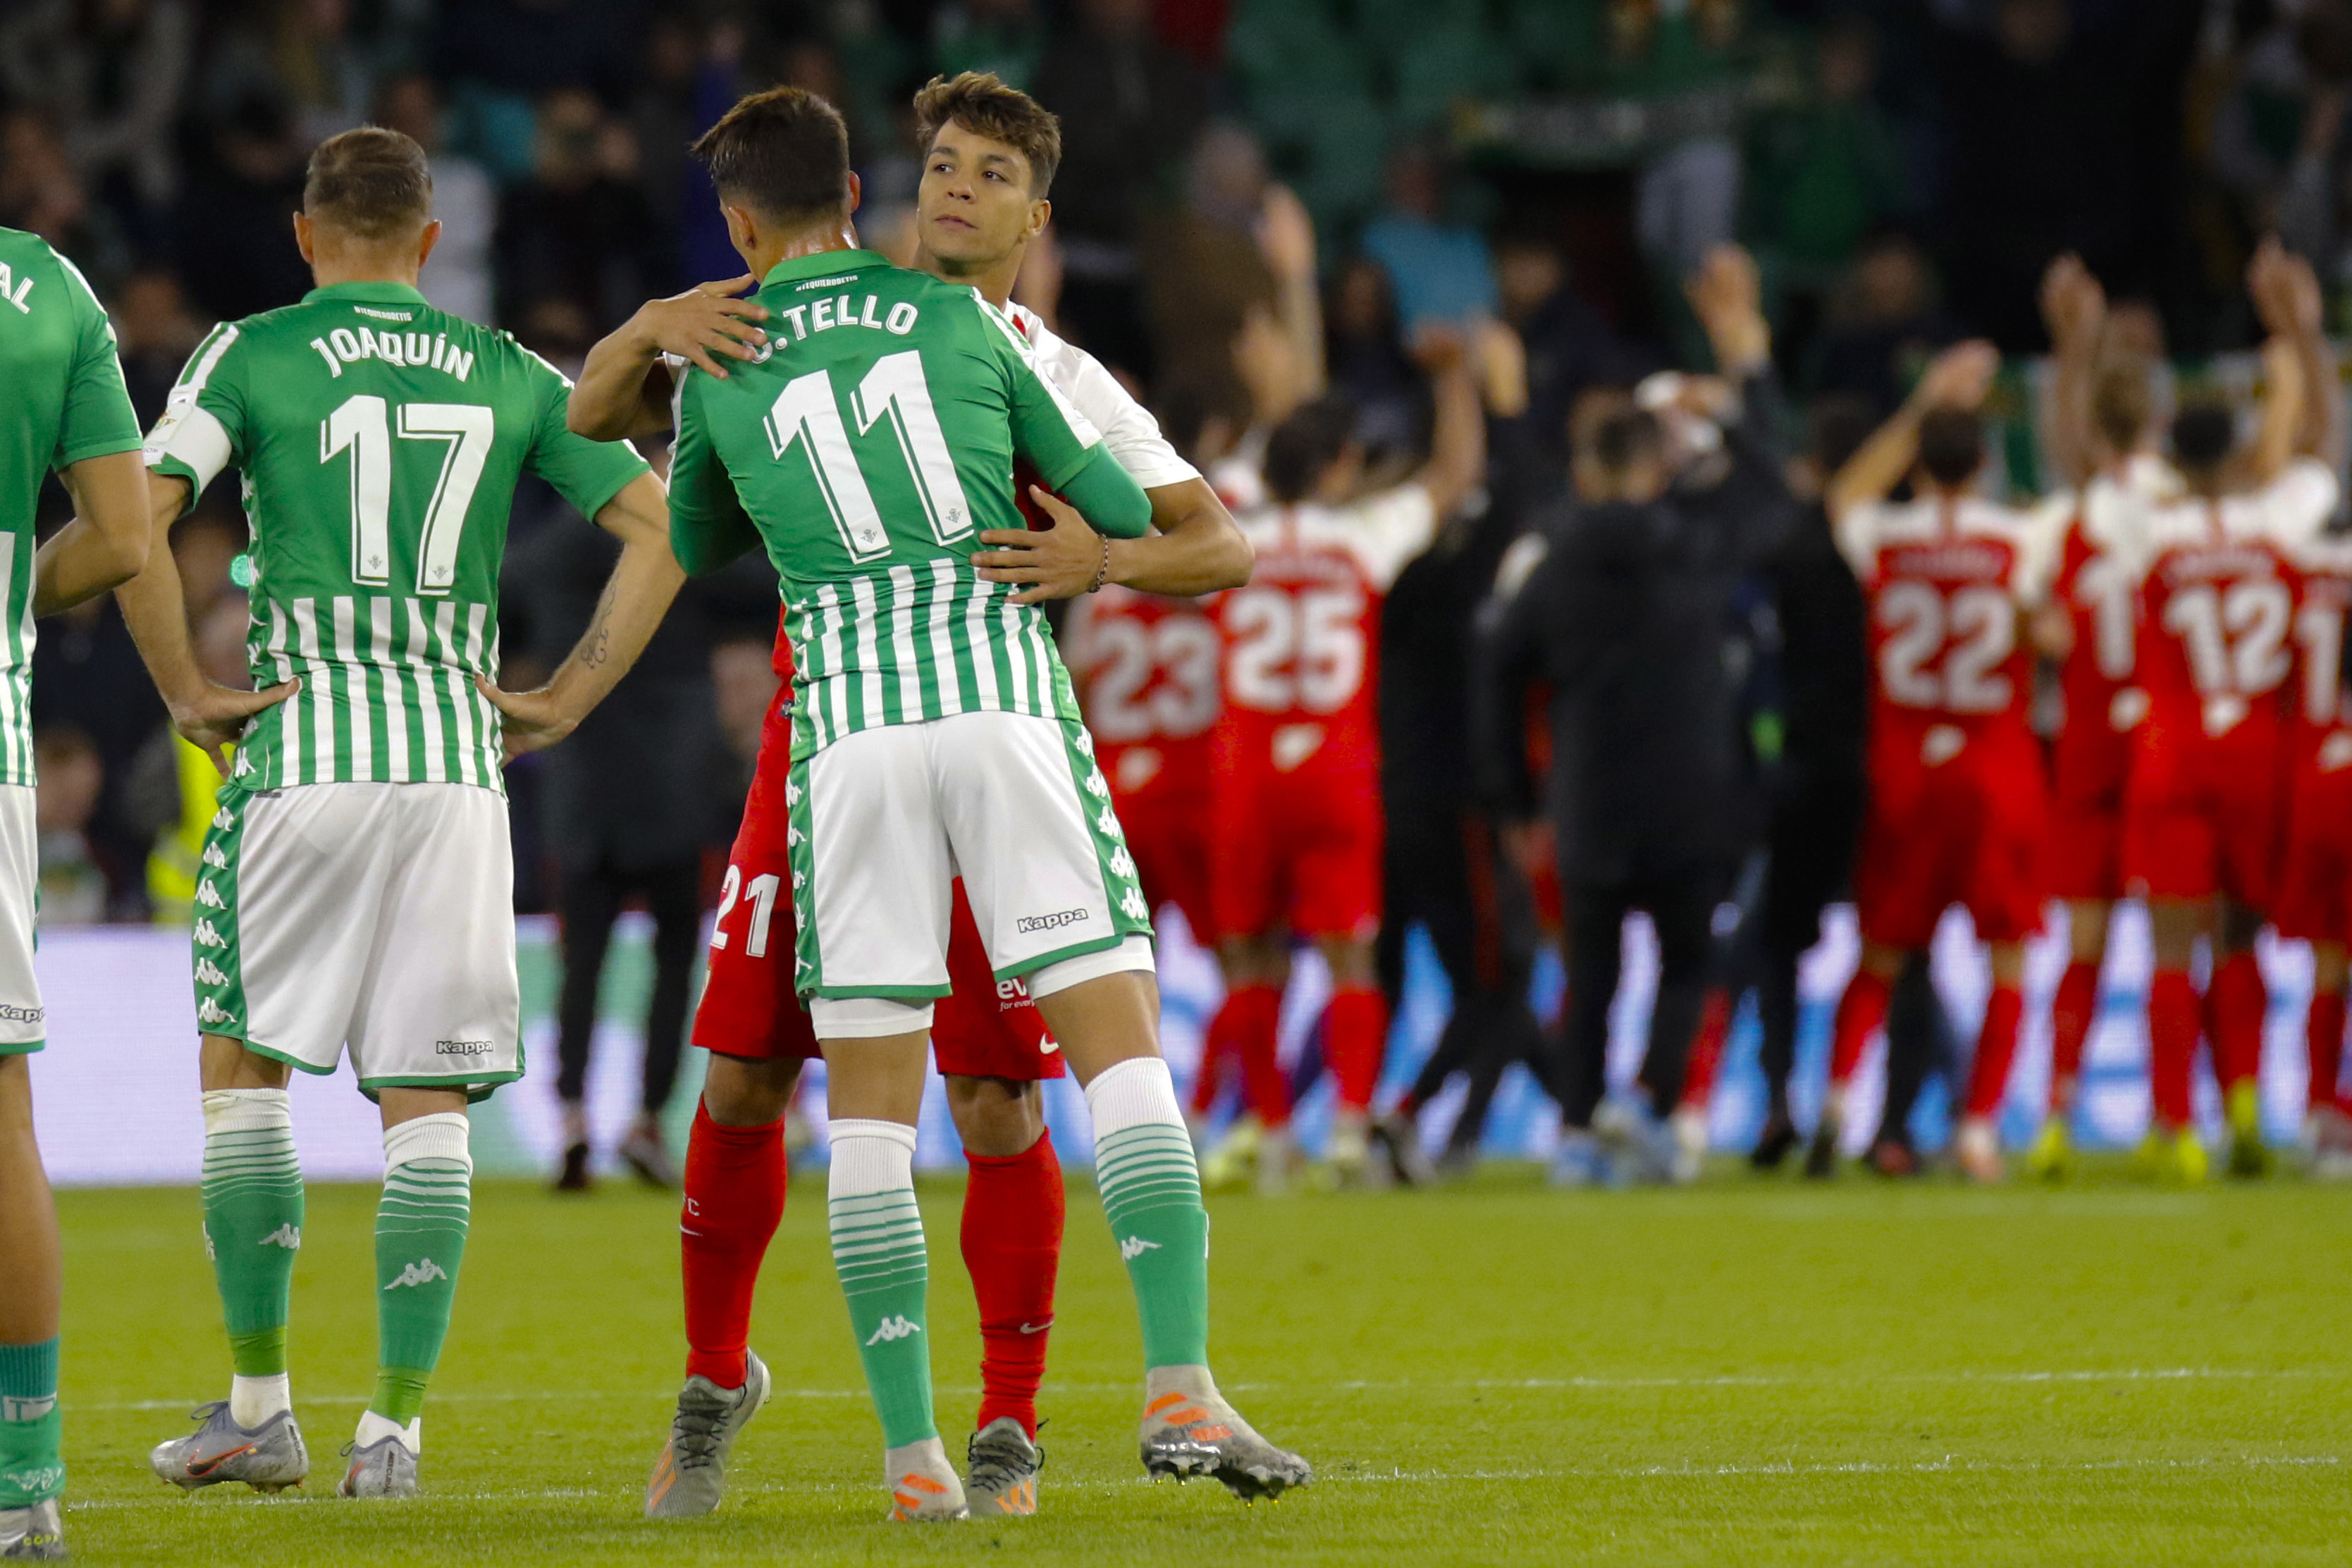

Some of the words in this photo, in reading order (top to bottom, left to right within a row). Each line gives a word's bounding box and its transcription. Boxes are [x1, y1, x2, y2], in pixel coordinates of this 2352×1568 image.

[310, 327, 474, 382] JOAQUÍN
[321, 395, 494, 596] 17
[763, 350, 975, 565] 11
[1087, 612, 1223, 743] 23
[1224, 586, 1367, 715] 25
[1875, 578, 2017, 716] 22
[2162, 576, 2293, 702] 12
[710, 864, 780, 958] 21
[1018, 908, 1089, 934] Kappa
[435, 1039, 494, 1056] Kappa
[999, 1001, 1014, 1012] for
